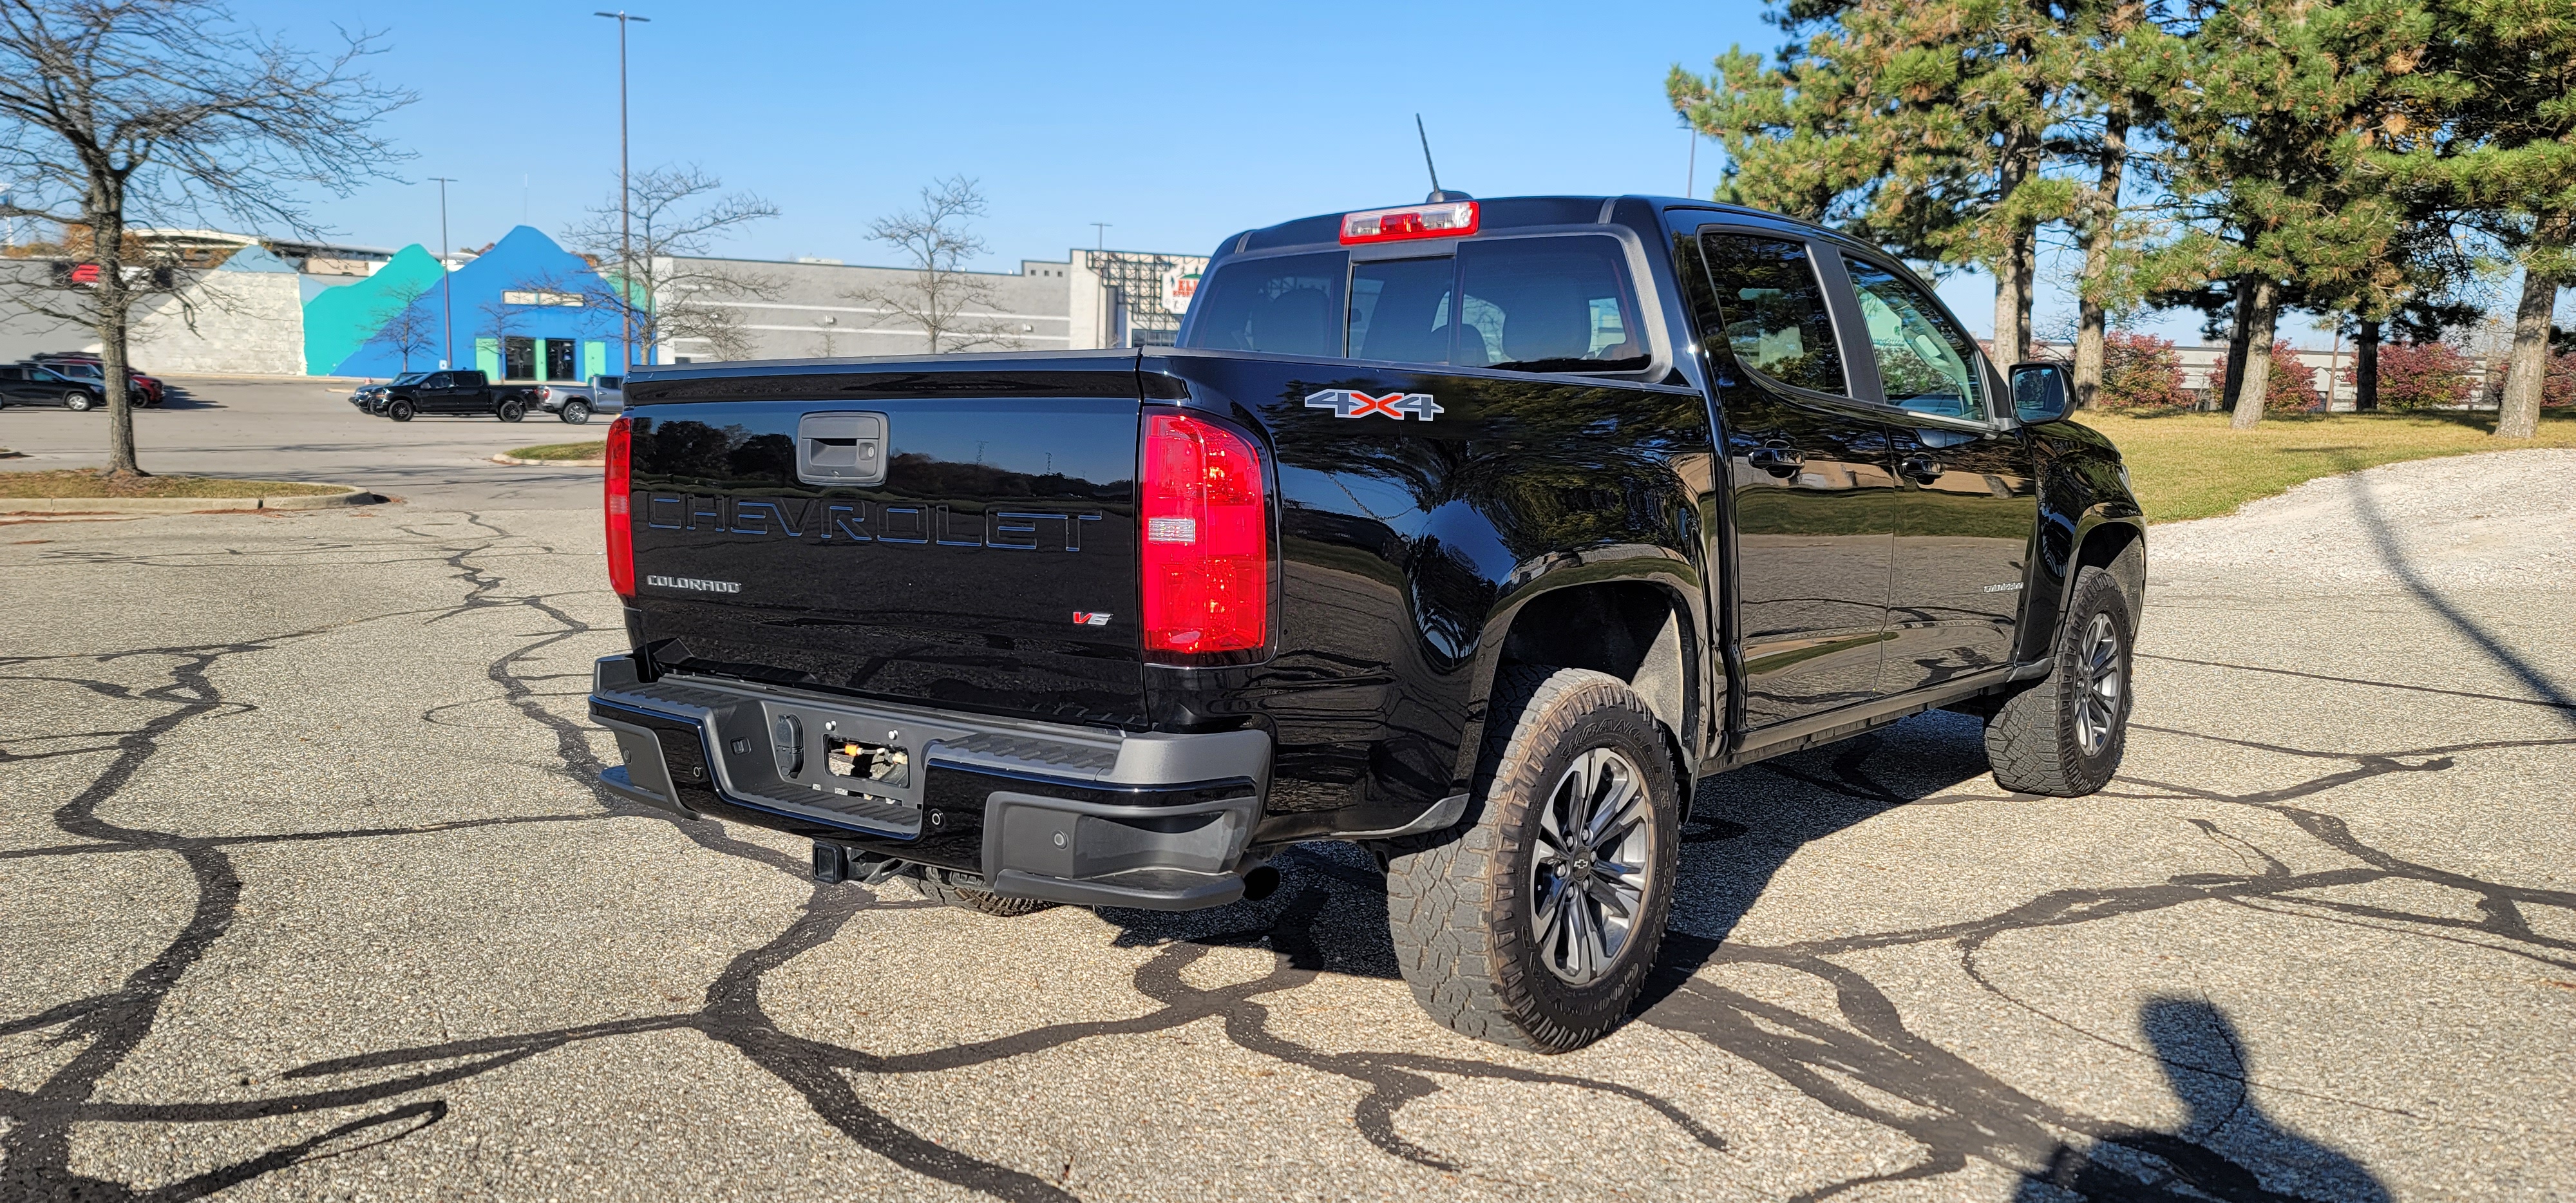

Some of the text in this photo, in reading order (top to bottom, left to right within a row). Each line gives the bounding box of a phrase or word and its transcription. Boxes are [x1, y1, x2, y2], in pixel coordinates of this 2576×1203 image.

[649, 492, 1103, 552] CHEVROLET
[647, 574, 742, 594] COLORADO
[1072, 611, 1112, 626] V6
[1560, 718, 1671, 810] WRANGLER
